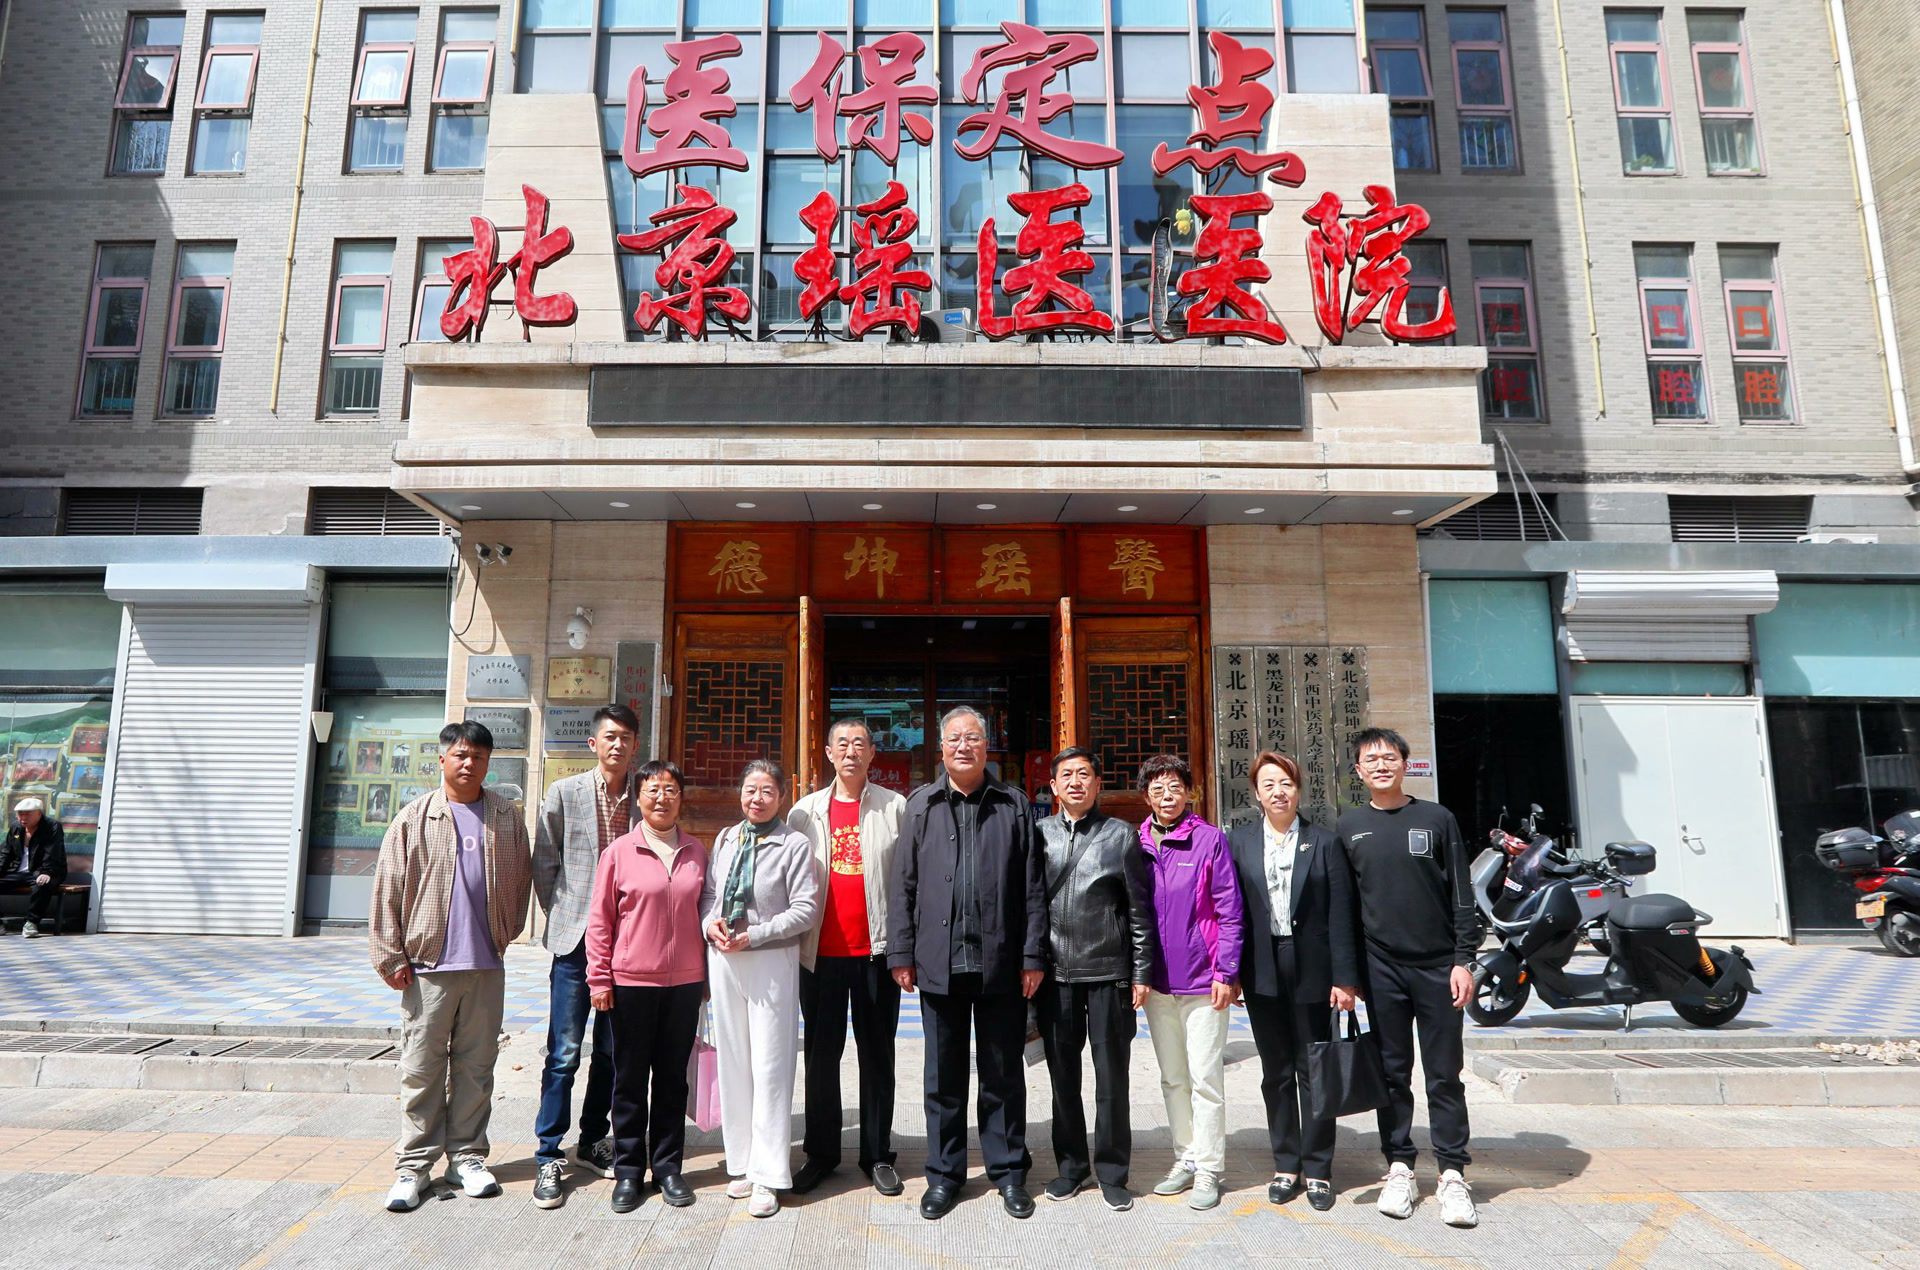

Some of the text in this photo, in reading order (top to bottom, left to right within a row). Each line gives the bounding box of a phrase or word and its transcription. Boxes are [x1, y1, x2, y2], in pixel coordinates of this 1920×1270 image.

[624, 21, 1306, 188] 医保定点
[439, 180, 1456, 346] 北京瑶医医院
[1652, 305, 1696, 402] 口腔
[1736, 305, 1781, 404] 口腔
